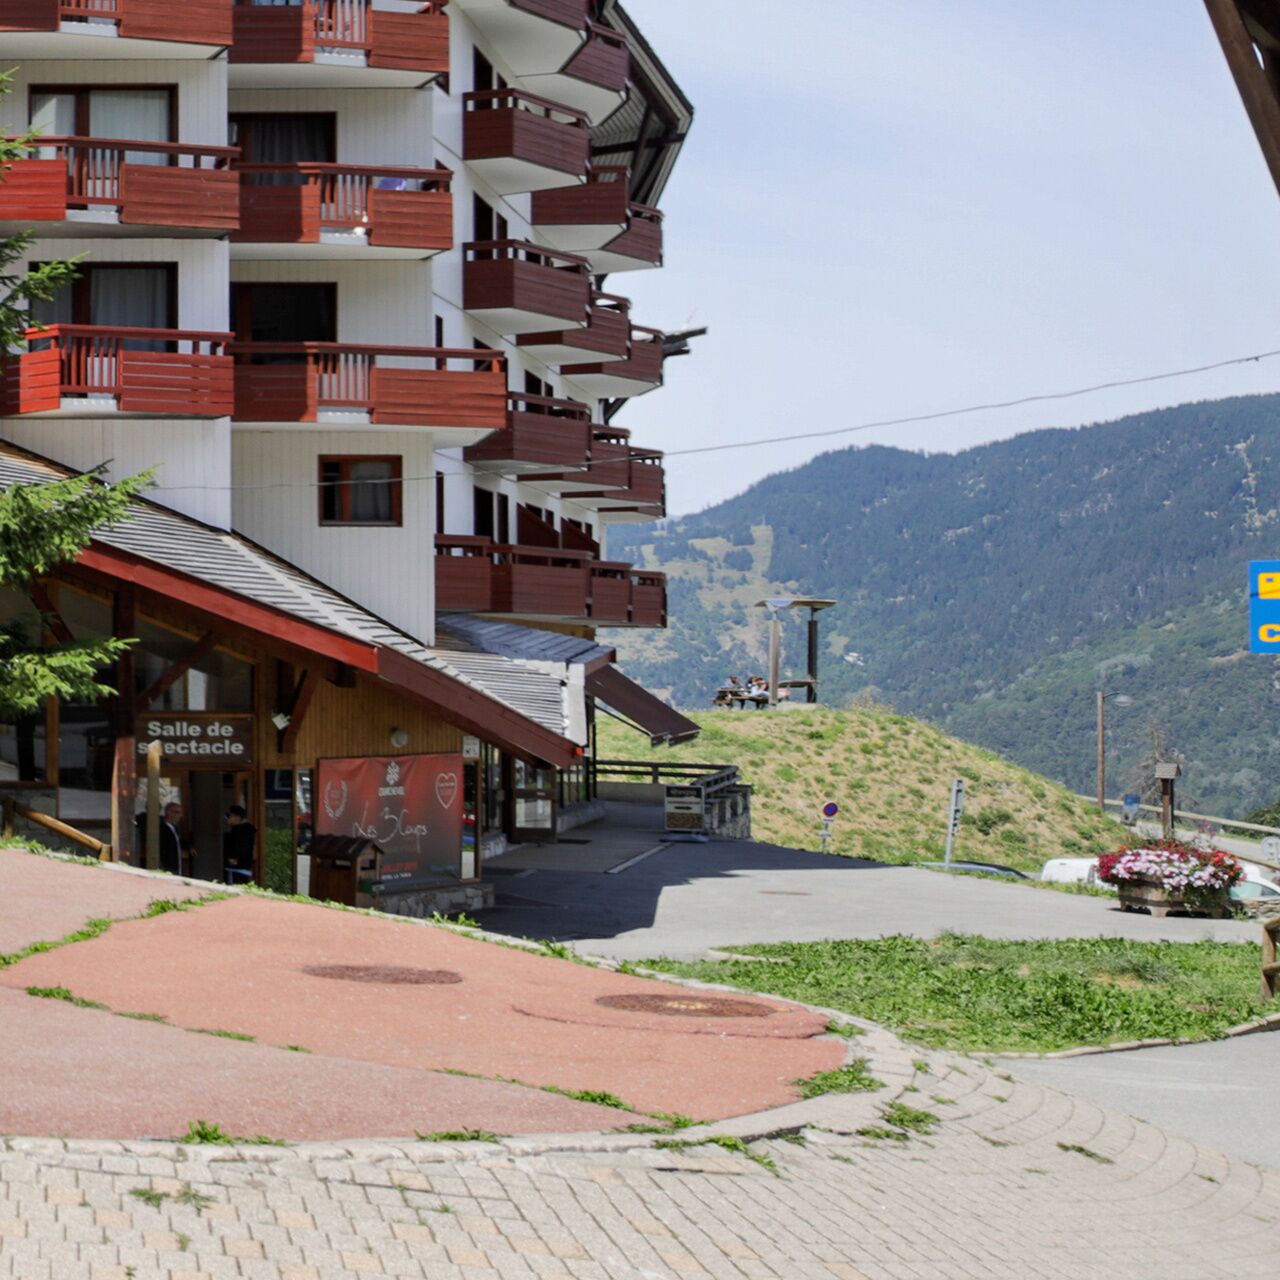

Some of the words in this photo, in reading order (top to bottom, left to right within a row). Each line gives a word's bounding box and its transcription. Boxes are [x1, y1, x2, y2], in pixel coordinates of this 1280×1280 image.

[147, 721, 201, 736] Salle
[207, 722, 233, 736] de
[137, 739, 244, 754] sectacle
